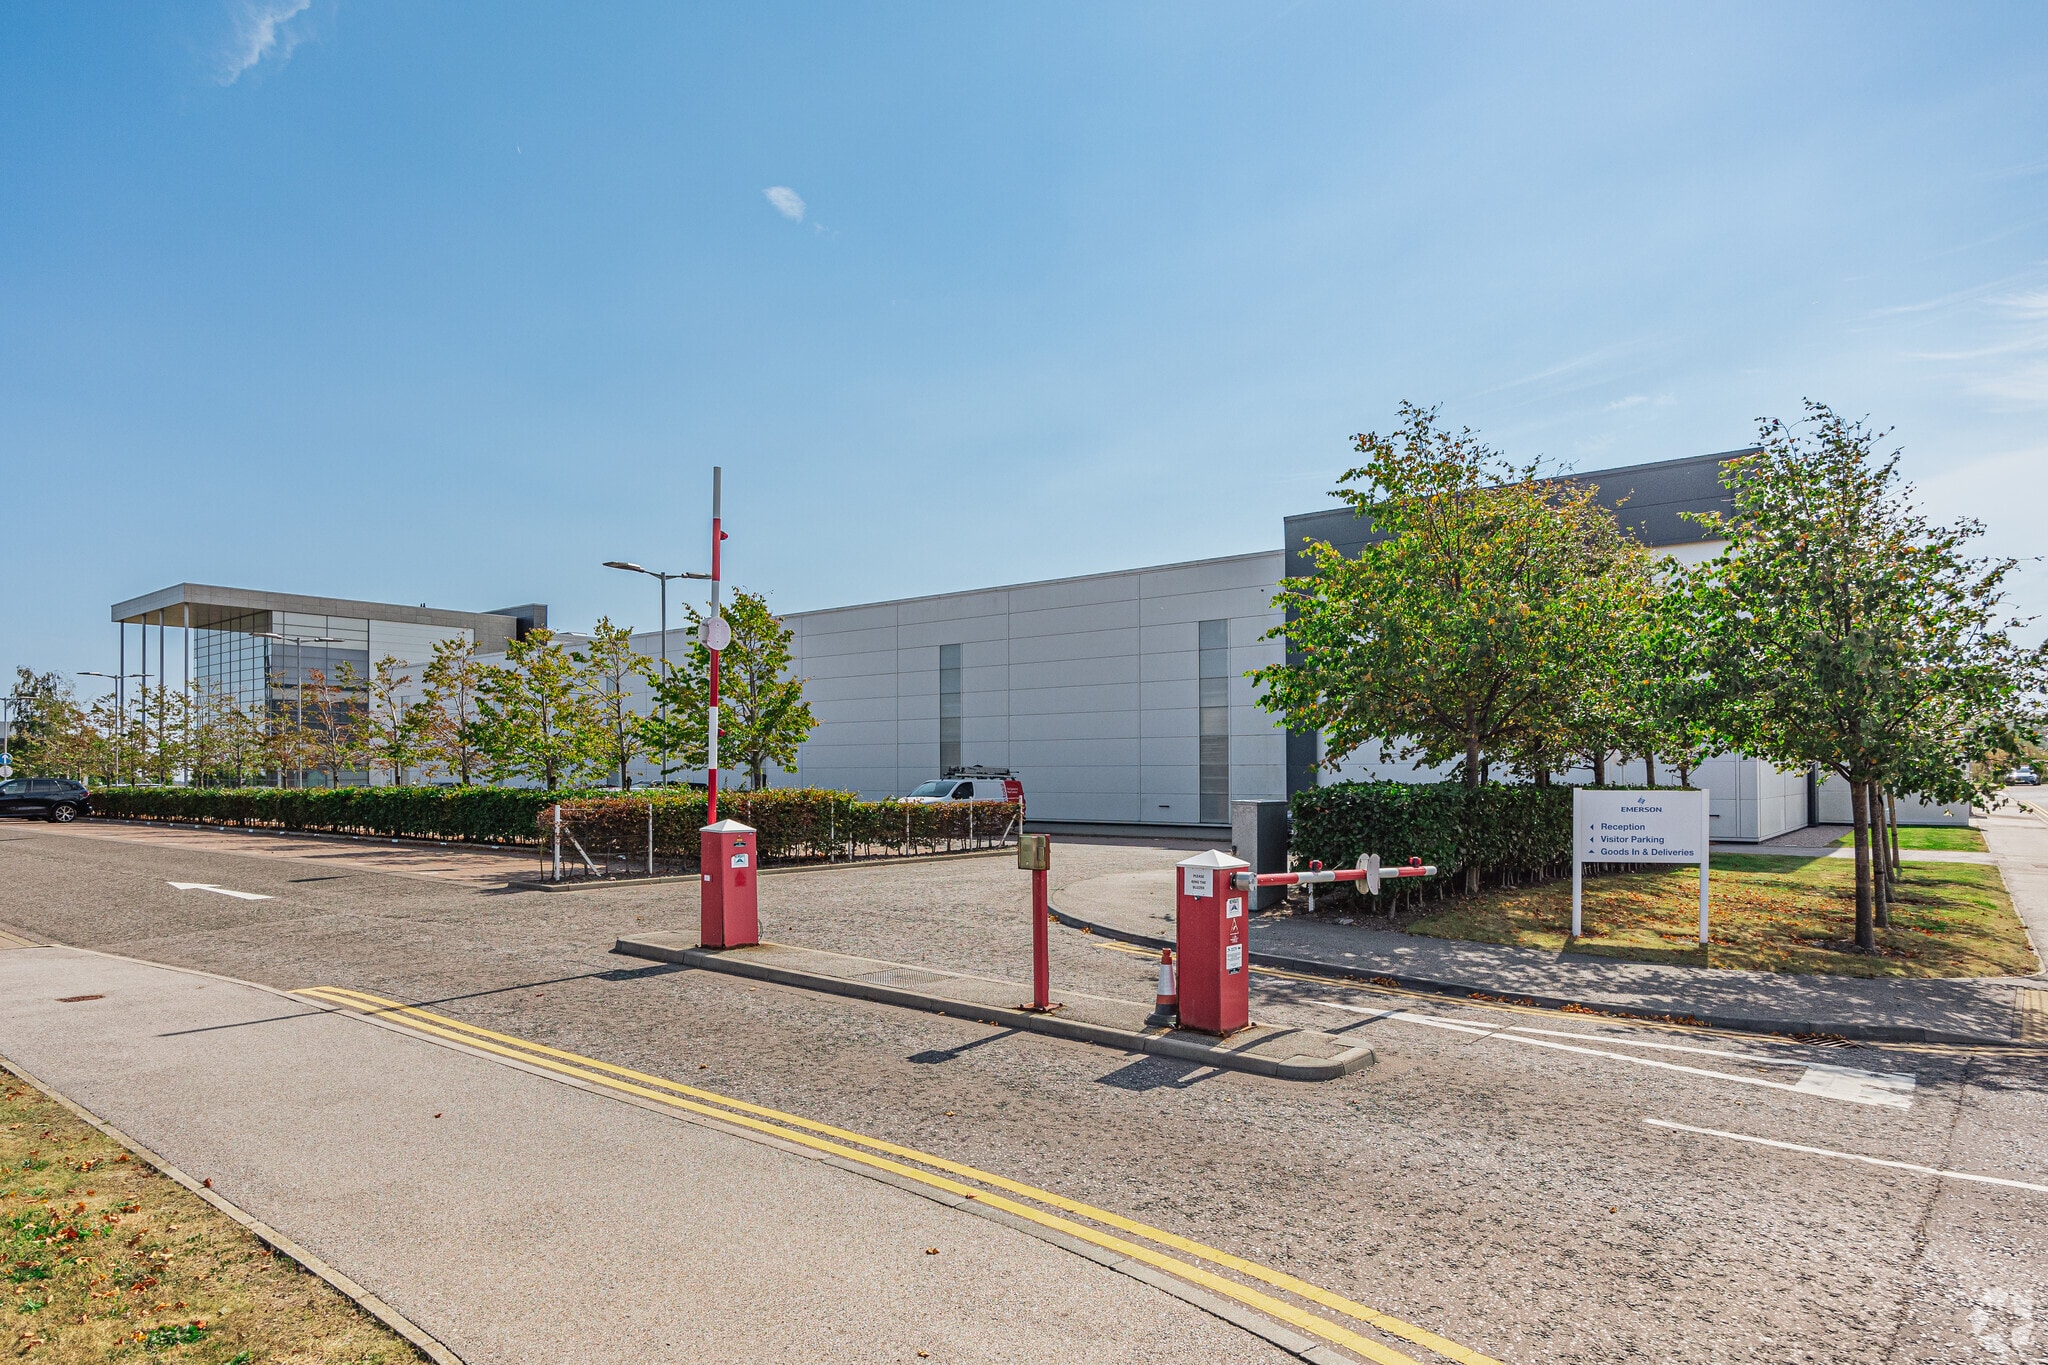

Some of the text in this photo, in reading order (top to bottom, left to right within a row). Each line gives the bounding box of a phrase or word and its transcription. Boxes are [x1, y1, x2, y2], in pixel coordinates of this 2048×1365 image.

[1600, 822, 1646, 832] Reception
[1630, 836, 1665, 844] Parking
[1600, 848, 1630, 856] Goods
[1642, 848, 1648, 856] &
[1651, 848, 1695, 856] Deliveries
